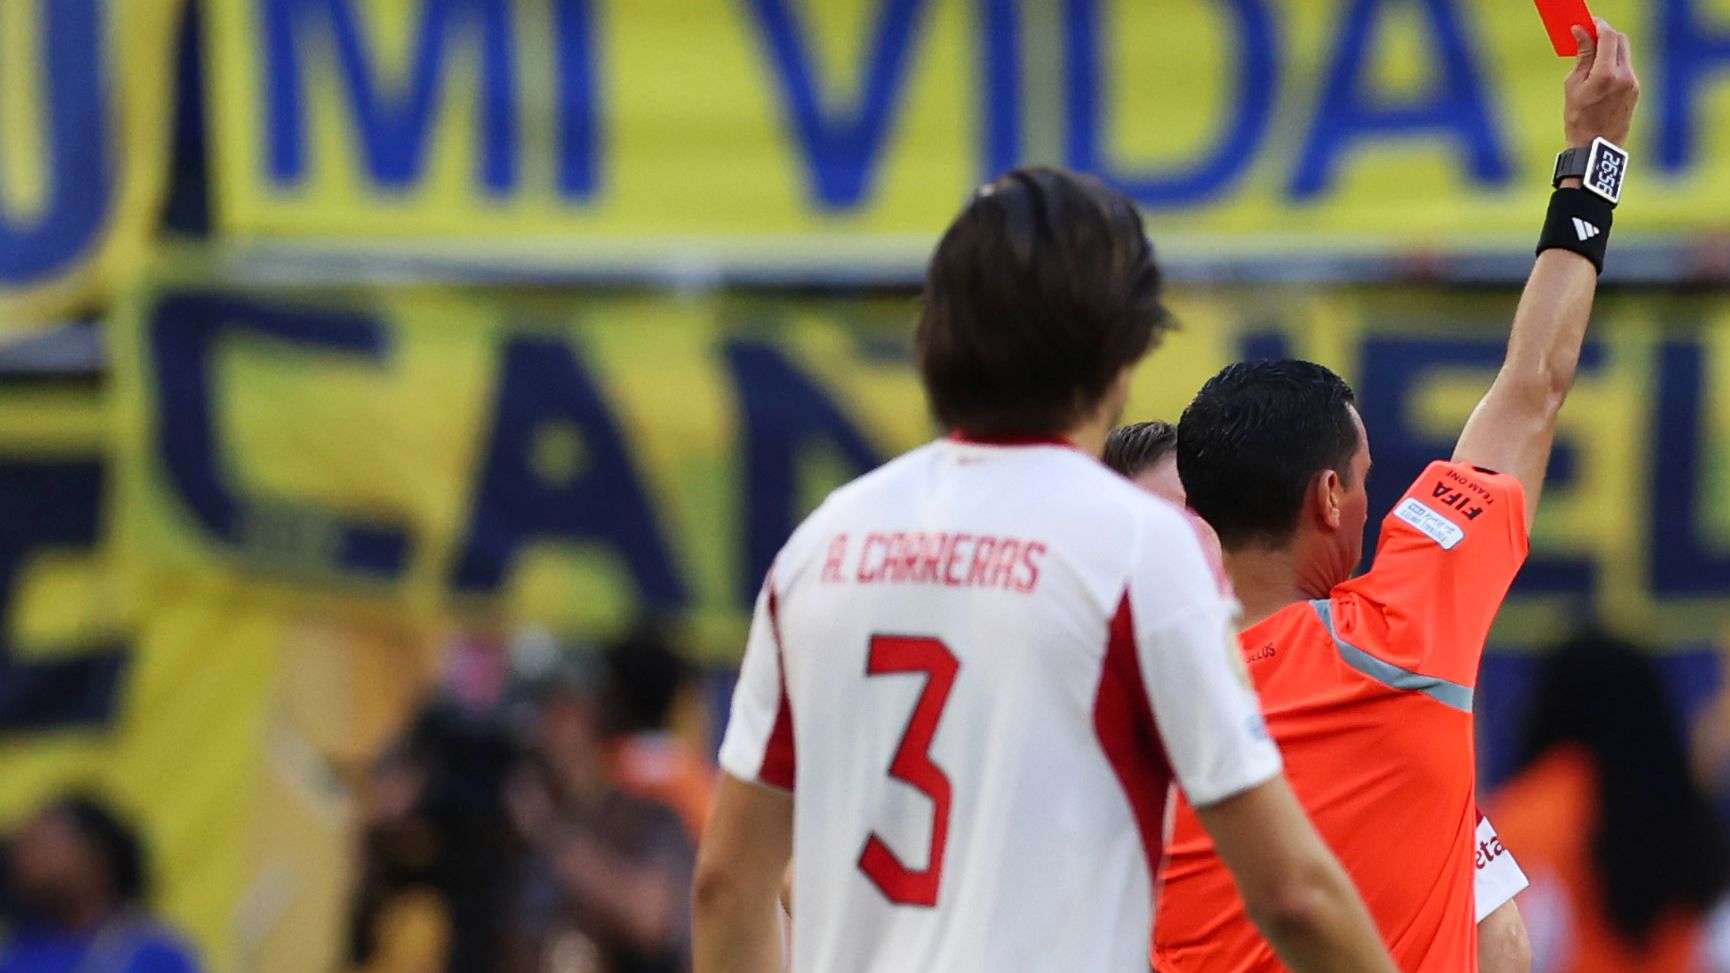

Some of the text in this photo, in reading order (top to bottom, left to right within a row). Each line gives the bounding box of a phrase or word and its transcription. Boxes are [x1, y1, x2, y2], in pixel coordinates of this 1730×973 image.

[748, 0, 1508, 205] VIDA
[1431, 481, 1483, 521] FIFA
[1467, 482, 1494, 505] TEAM
[857, 531, 1049, 595] CARRERAS
[858, 634, 961, 906] 3
